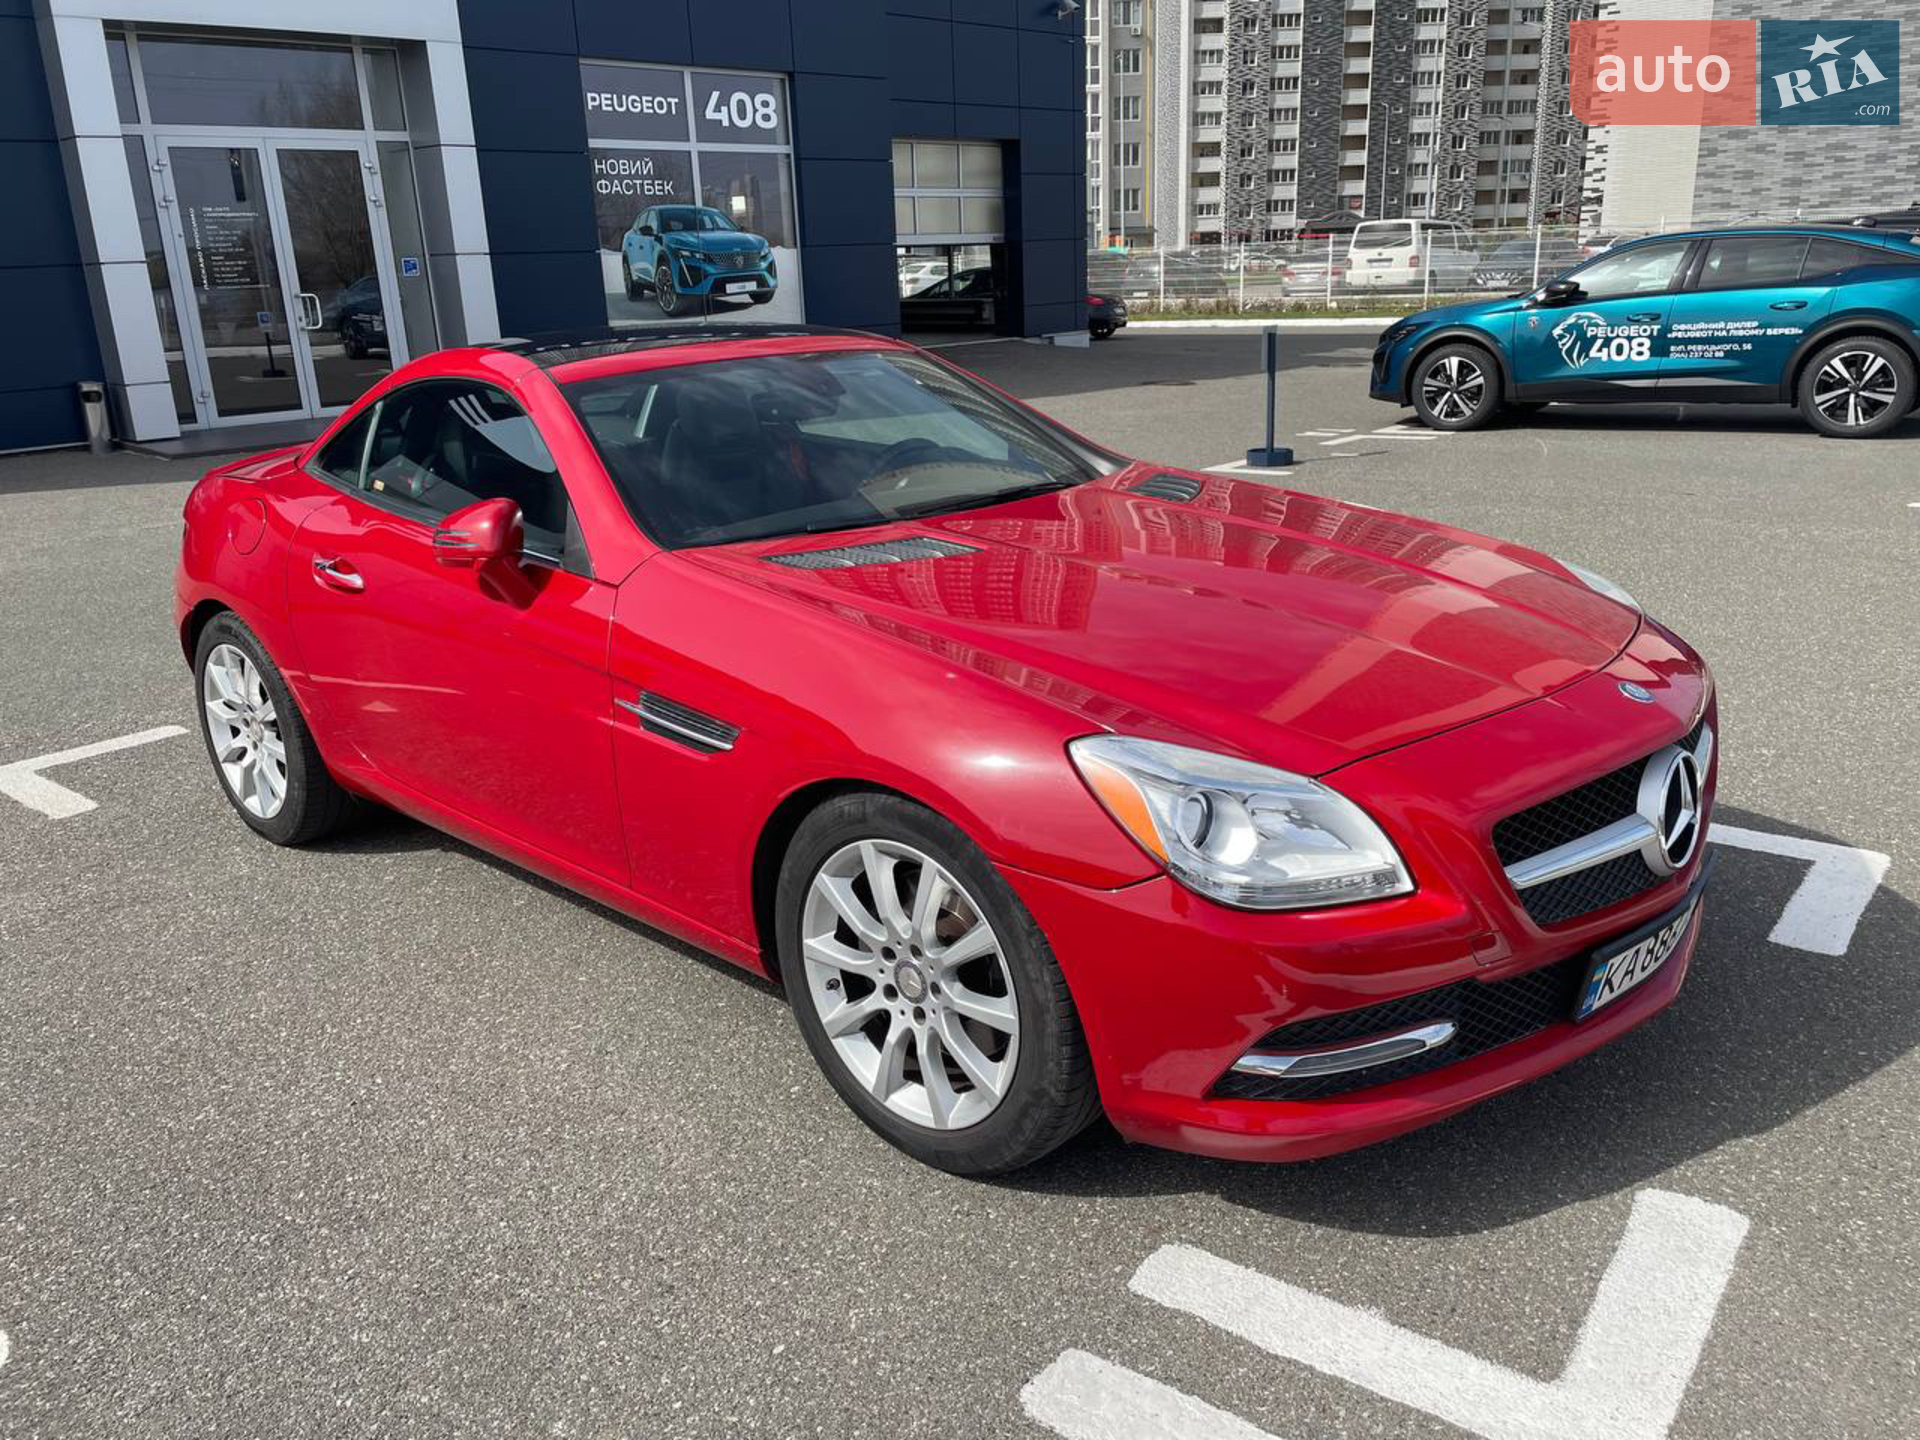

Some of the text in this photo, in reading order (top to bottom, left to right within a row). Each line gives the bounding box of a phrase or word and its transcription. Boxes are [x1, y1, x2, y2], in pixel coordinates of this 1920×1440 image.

[586, 90, 778, 129] PEUGEOT 408
[594, 157, 654, 175] НОВИЙ
[596, 179, 674, 196] ФАСТБЕК
[1586, 324, 1661, 337] PEUGEOT
[1714, 329, 1728, 337] НА
[1588, 337, 1651, 362] 408
